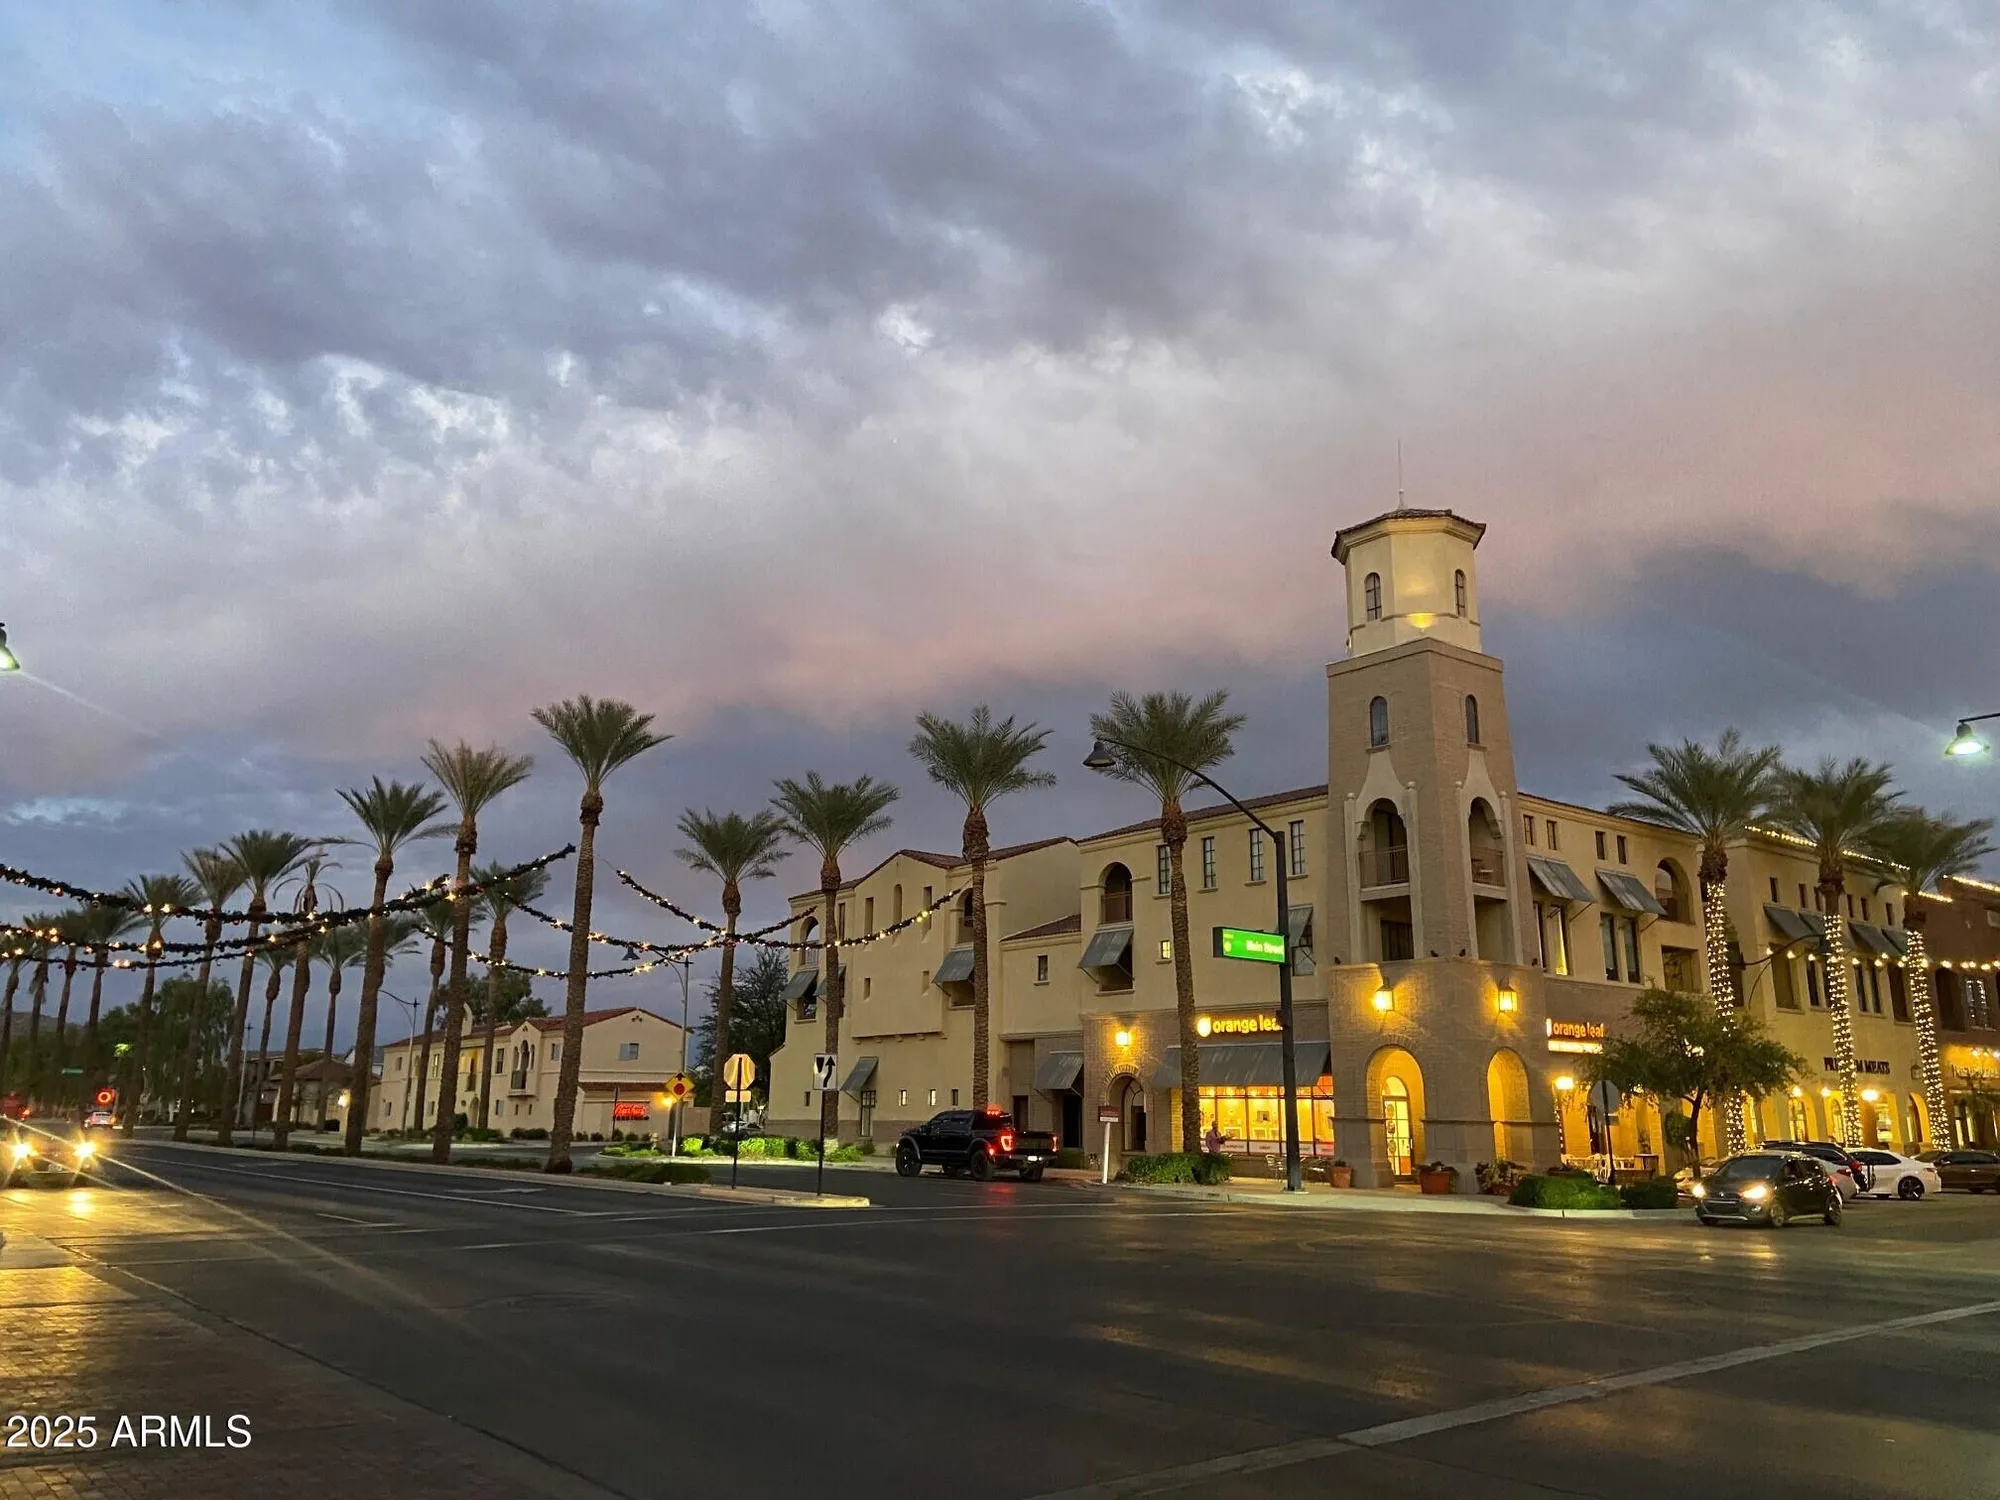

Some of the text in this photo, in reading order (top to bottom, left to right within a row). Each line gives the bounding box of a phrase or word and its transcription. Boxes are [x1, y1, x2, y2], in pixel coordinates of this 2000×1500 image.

[1212, 1014, 1283, 1034] orange lea
[1552, 1021, 1604, 1039] orange leaf
[1865, 1060, 1890, 1074] MEATS
